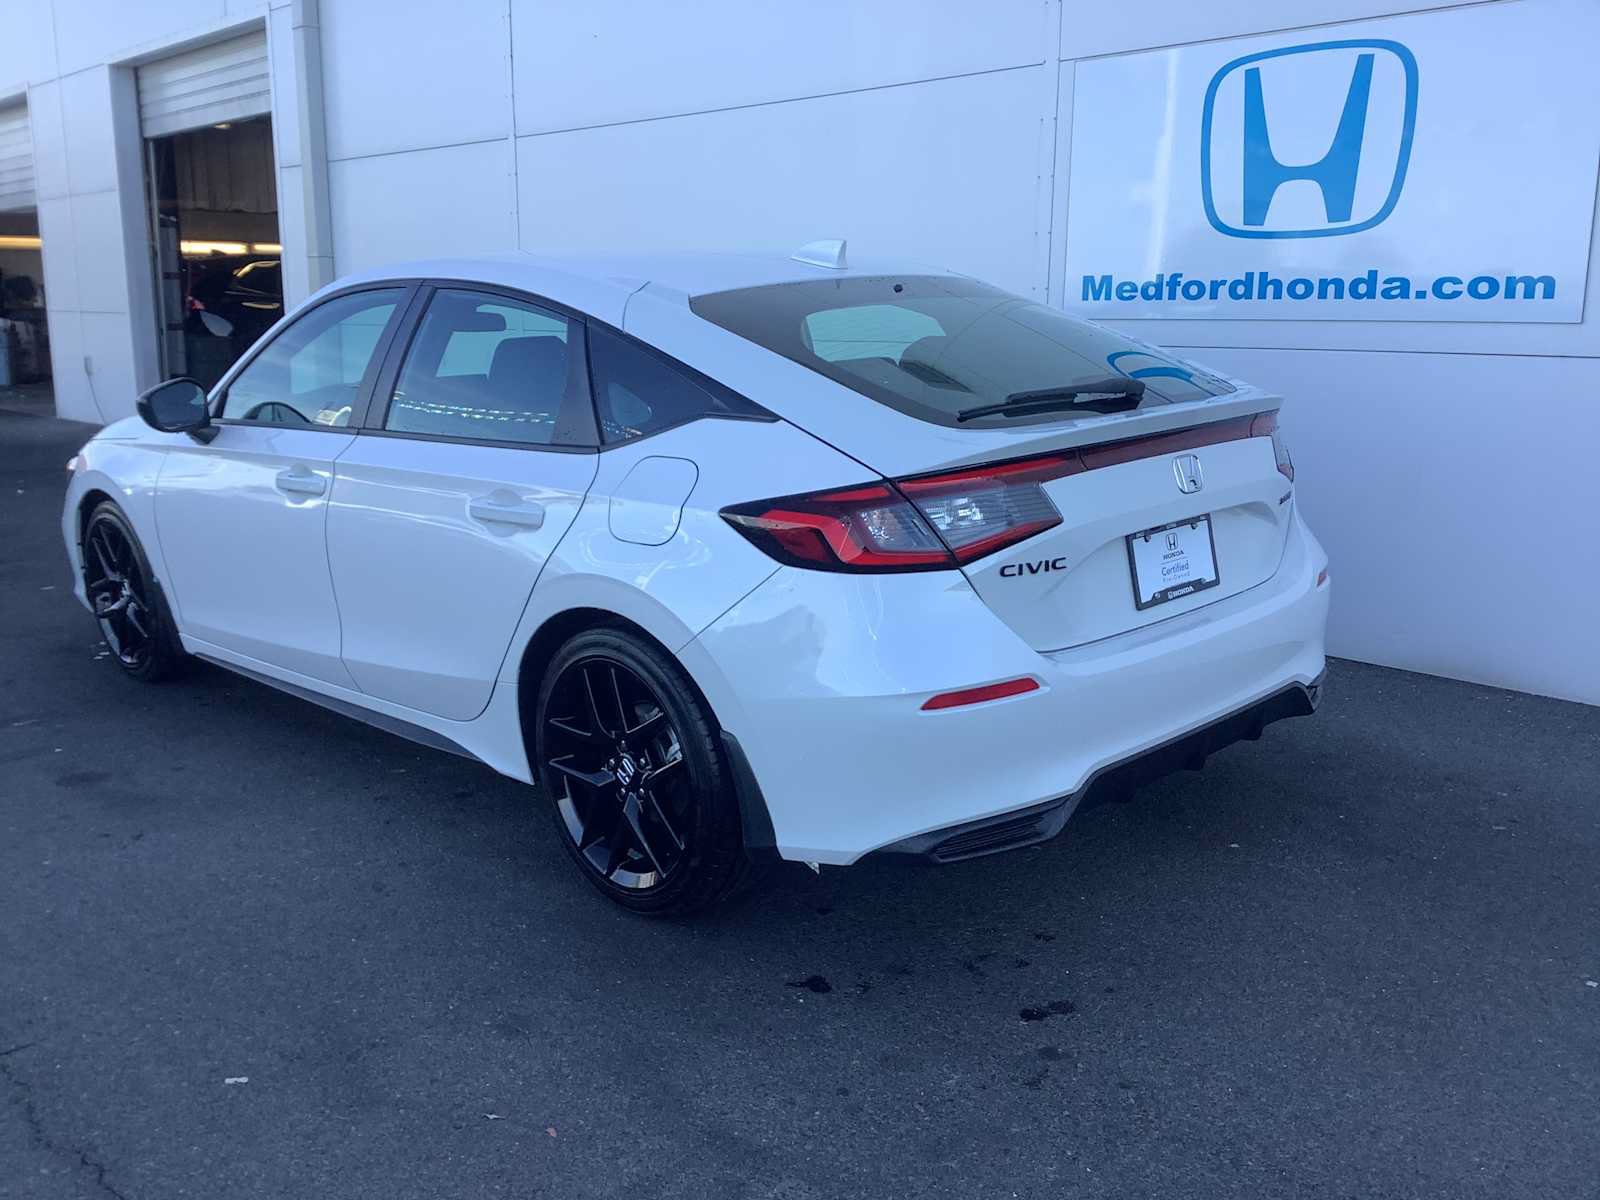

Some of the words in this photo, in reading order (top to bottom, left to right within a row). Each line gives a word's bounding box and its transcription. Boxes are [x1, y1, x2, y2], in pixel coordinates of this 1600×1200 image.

[1081, 269, 1556, 301] Medfordhonda.com
[1163, 550, 1184, 561] HONDA
[999, 557, 1067, 577] CIVIC
[1161, 560, 1189, 576] Certified
[1172, 585, 1194, 598] HONDA
